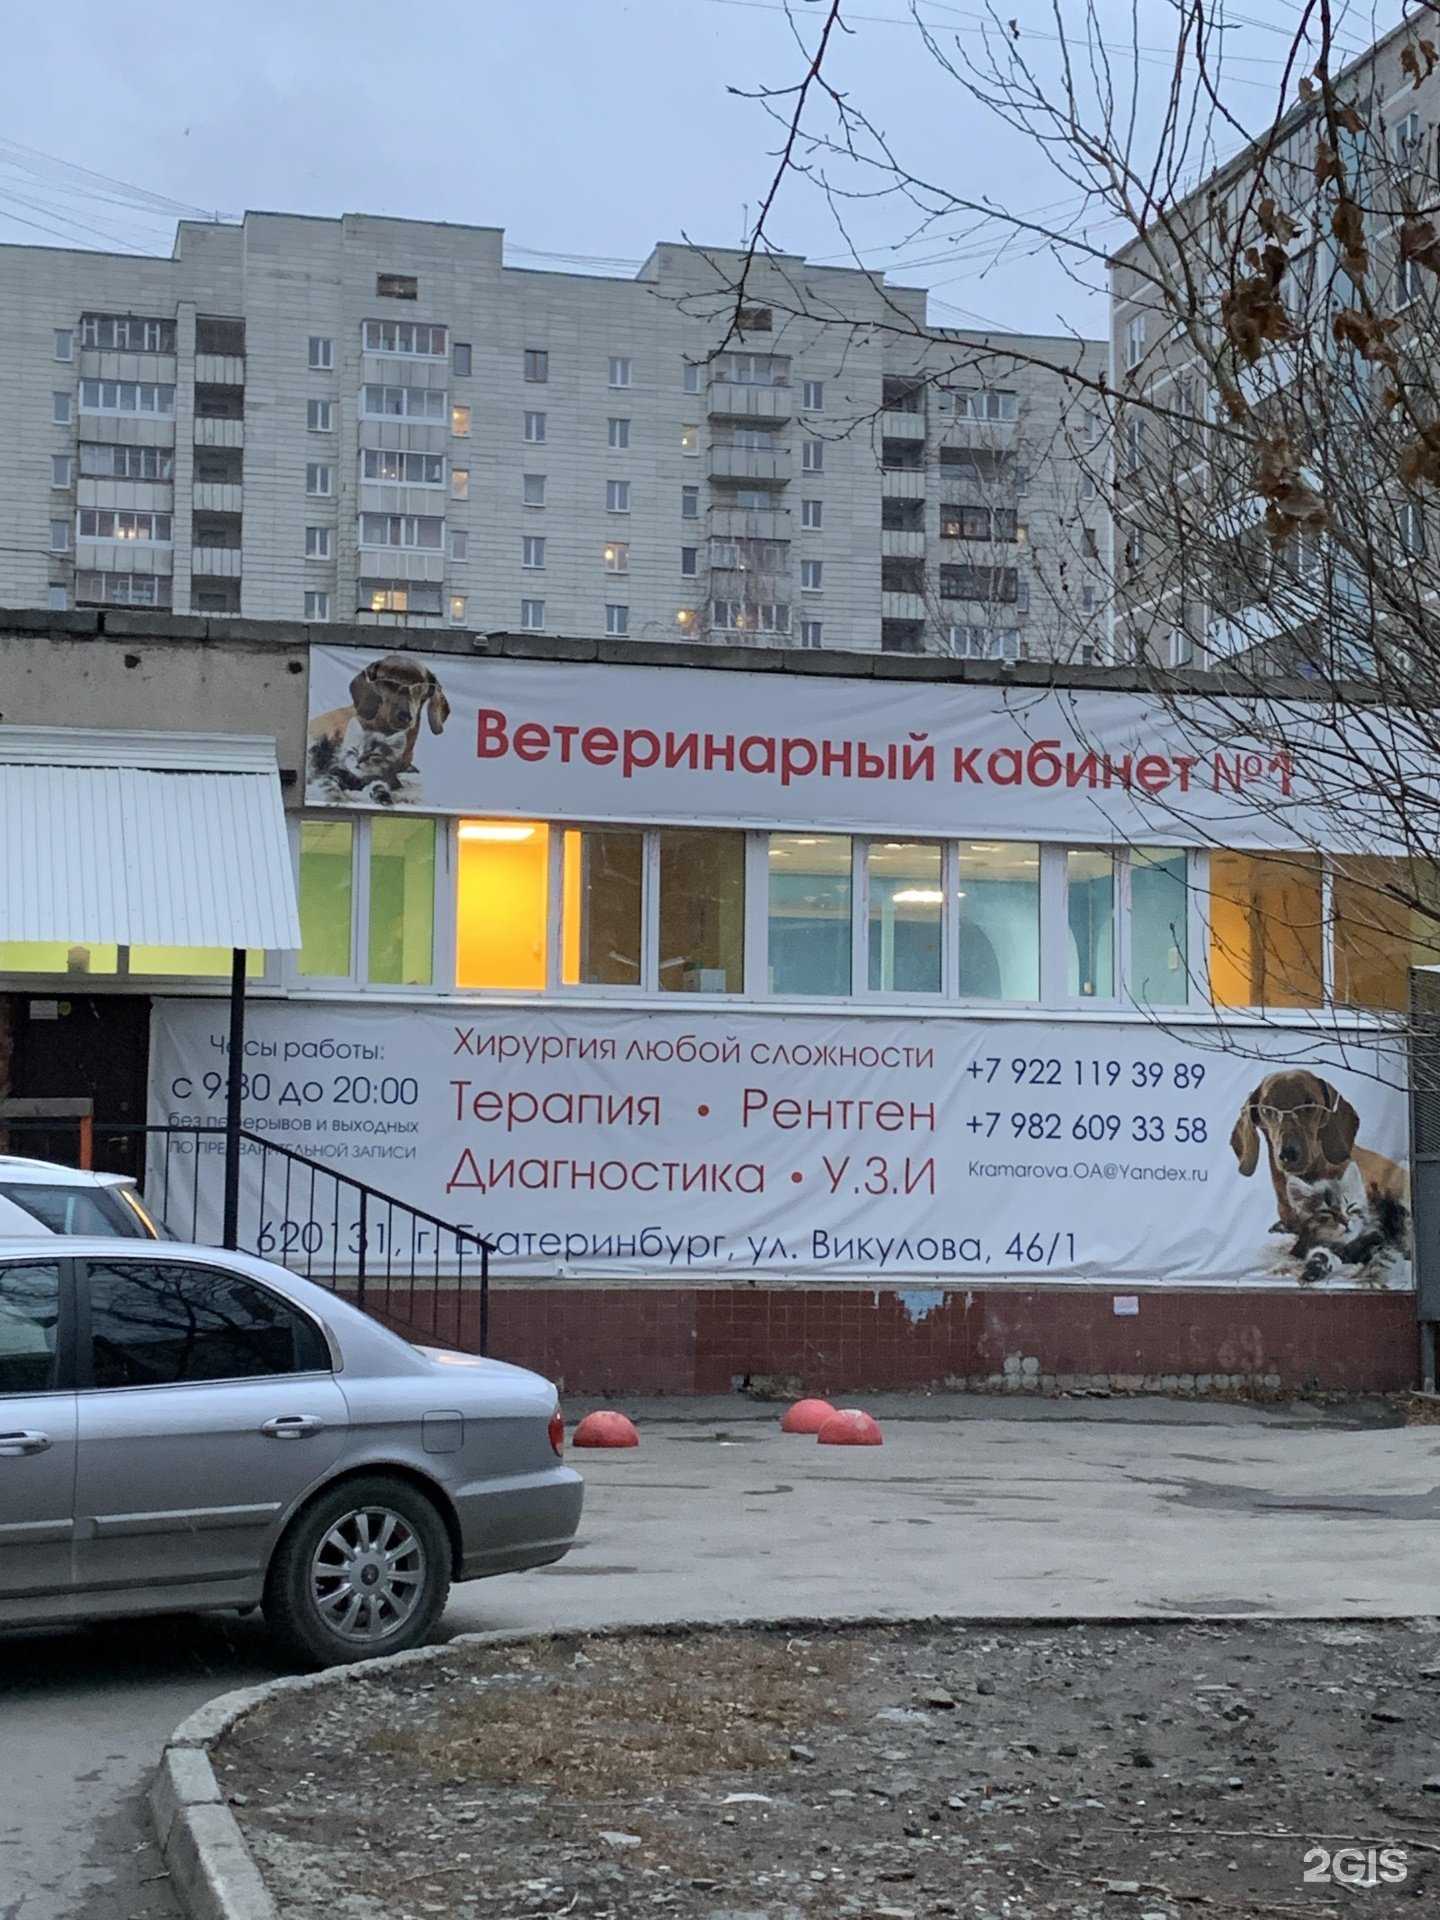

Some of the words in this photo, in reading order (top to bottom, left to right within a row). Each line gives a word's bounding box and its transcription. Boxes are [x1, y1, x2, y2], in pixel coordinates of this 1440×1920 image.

[477, 709, 935, 786] Ветеринарный
[953, 740, 1199, 794] кабинет
[210, 1034, 277, 1057] Чсы
[284, 1039, 385, 1062] работы:
[453, 1026, 616, 1064] Хирургия
[625, 1035, 741, 1064] любой
[750, 1042, 934, 1068] сложности
[966, 1058, 1002, 1083] +7
[1011, 1058, 1062, 1085] 922
[1075, 1060, 1121, 1087] 119
[1131, 1061, 1164, 1088] 39
[1173, 1063, 1206, 1090] 89
[172, 1077, 193, 1099] с
[279, 1081, 323, 1106] до
[333, 1076, 419, 1105] 20:00
[450, 1080, 660, 1132] Терапия
[743, 1088, 935, 1132] Рентген
[168, 1112, 201, 1128] без
[206, 1116, 312, 1132] пеерывов
[316, 1119, 328, 1131] и
[332, 1119, 419, 1135] выходных
[966, 1112, 1002, 1139] +7
[1011, 1112, 1062, 1140] 982
[1072, 1114, 1122, 1142] 609
[1131, 1115, 1165, 1142] 33
[1173, 1117, 1208, 1144] 58
[352, 1144, 417, 1160] ЗАПИСИ
[446, 1147, 765, 1195] Диагностика
[822, 1155, 935, 1195] У.З.И
[969, 1160, 1209, 1182] Kramarova.OA@Yandex.ru
[456, 1224, 735, 1263] Екатеринбург,
[747, 1233, 798, 1264] ул.
[812, 1229, 992, 1266] Викулова,
[1005, 1232, 1076, 1266] 46/1
